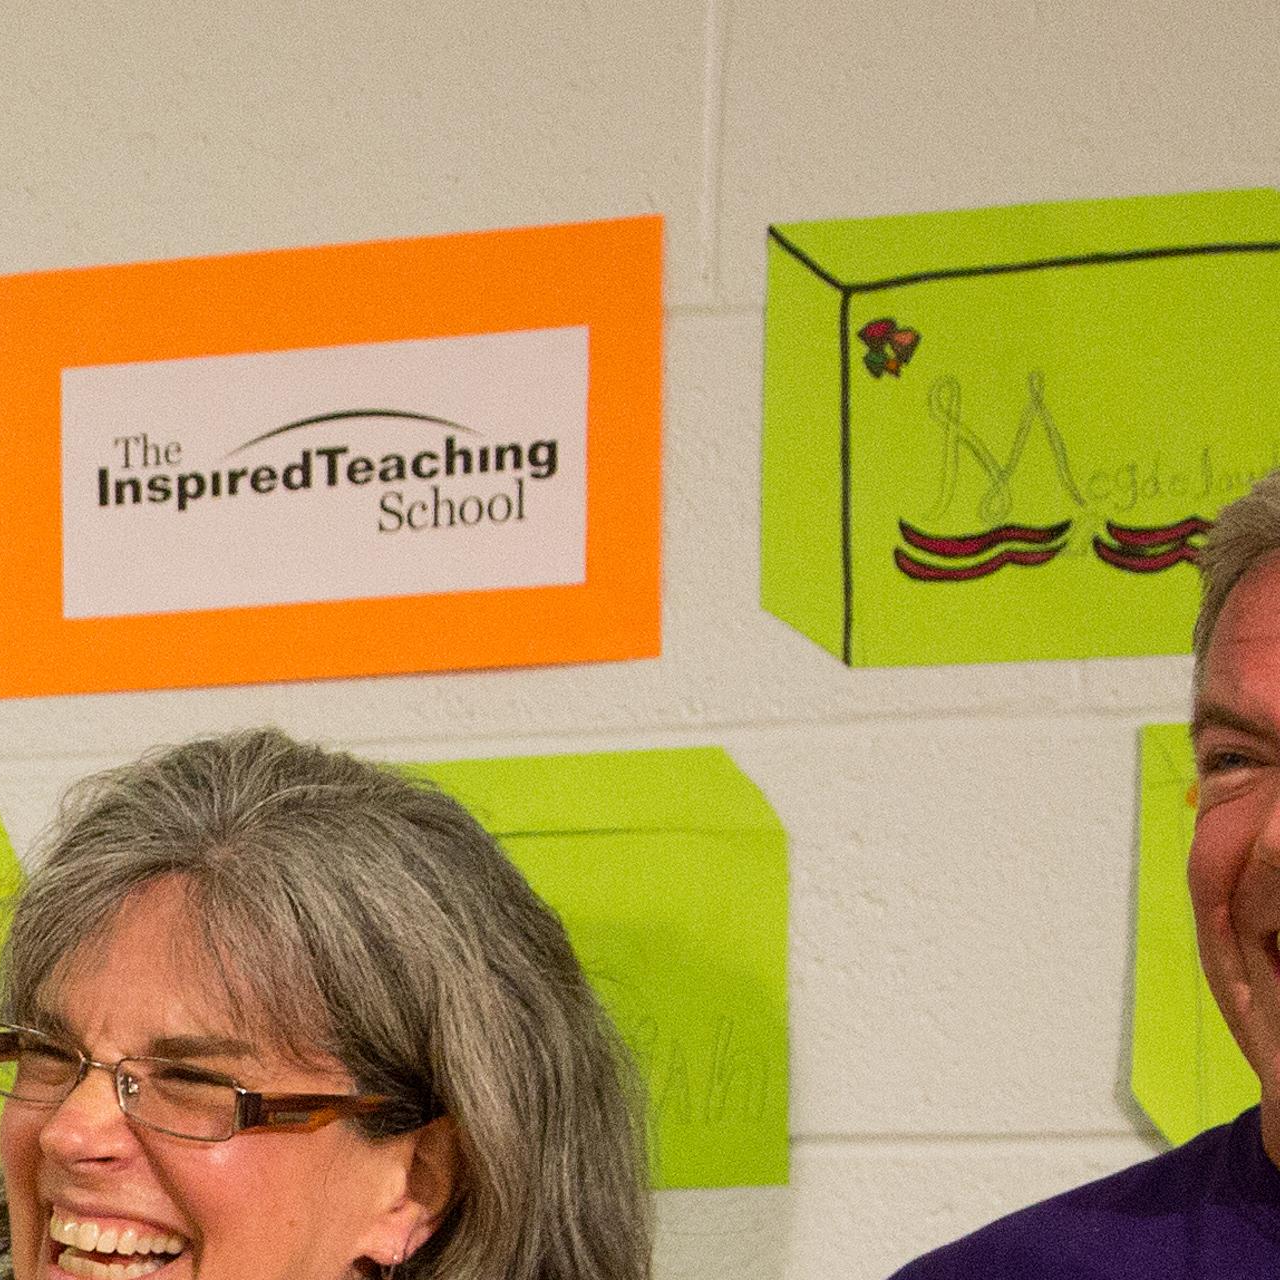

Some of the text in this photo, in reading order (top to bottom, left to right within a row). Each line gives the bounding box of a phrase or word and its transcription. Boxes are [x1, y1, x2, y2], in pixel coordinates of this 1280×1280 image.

[97, 435, 559, 512] InspiredTeaching
[114, 431, 182, 468] The
[377, 480, 527, 533] School
